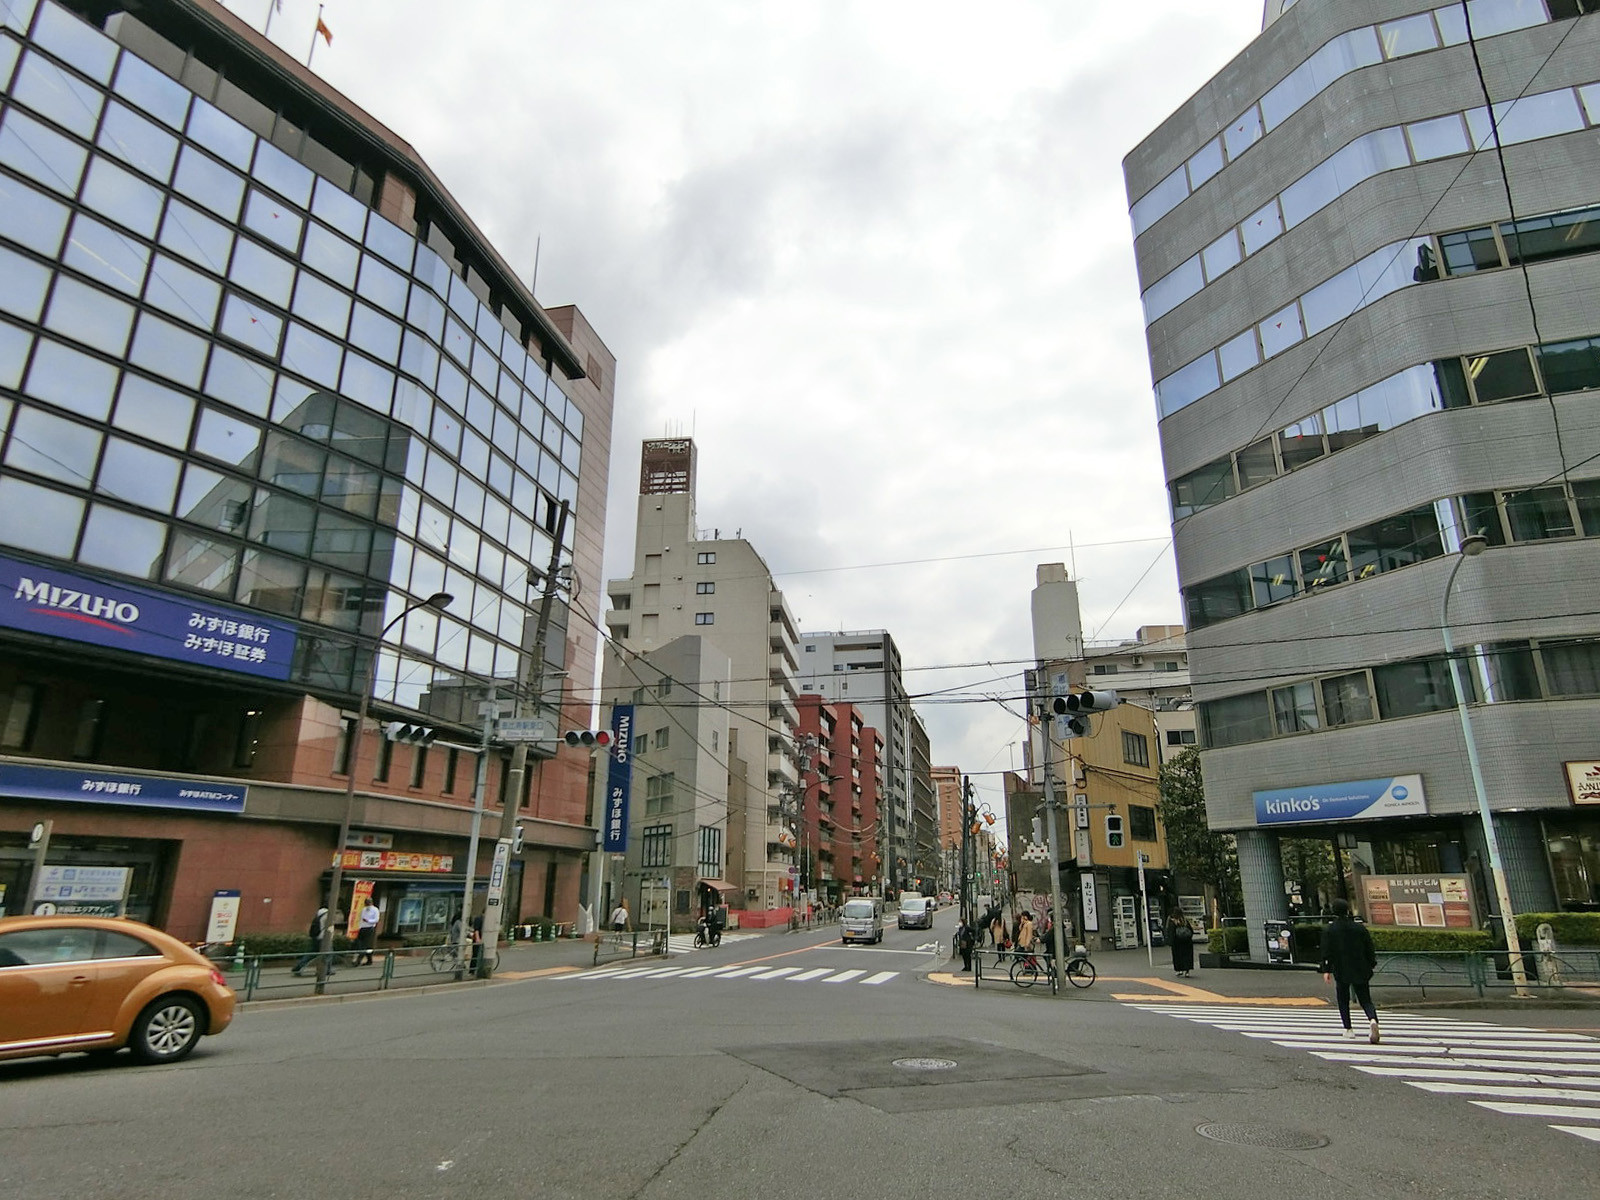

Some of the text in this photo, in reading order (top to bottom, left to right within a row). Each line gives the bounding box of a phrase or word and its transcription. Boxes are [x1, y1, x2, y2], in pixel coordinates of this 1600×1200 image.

[14, 577, 140, 623] MIZUHO
[188, 612, 271, 644] みずほ銀行
[184, 633, 267, 664] みずほ証券
[617, 715, 630, 764] MIZUHO
[81, 779, 142, 796] みずほ銀行
[179, 789, 239, 801] みずほATMコーナー
[610, 787, 623, 841] みずほ銀行
[1266, 795, 1321, 815] kinko's
